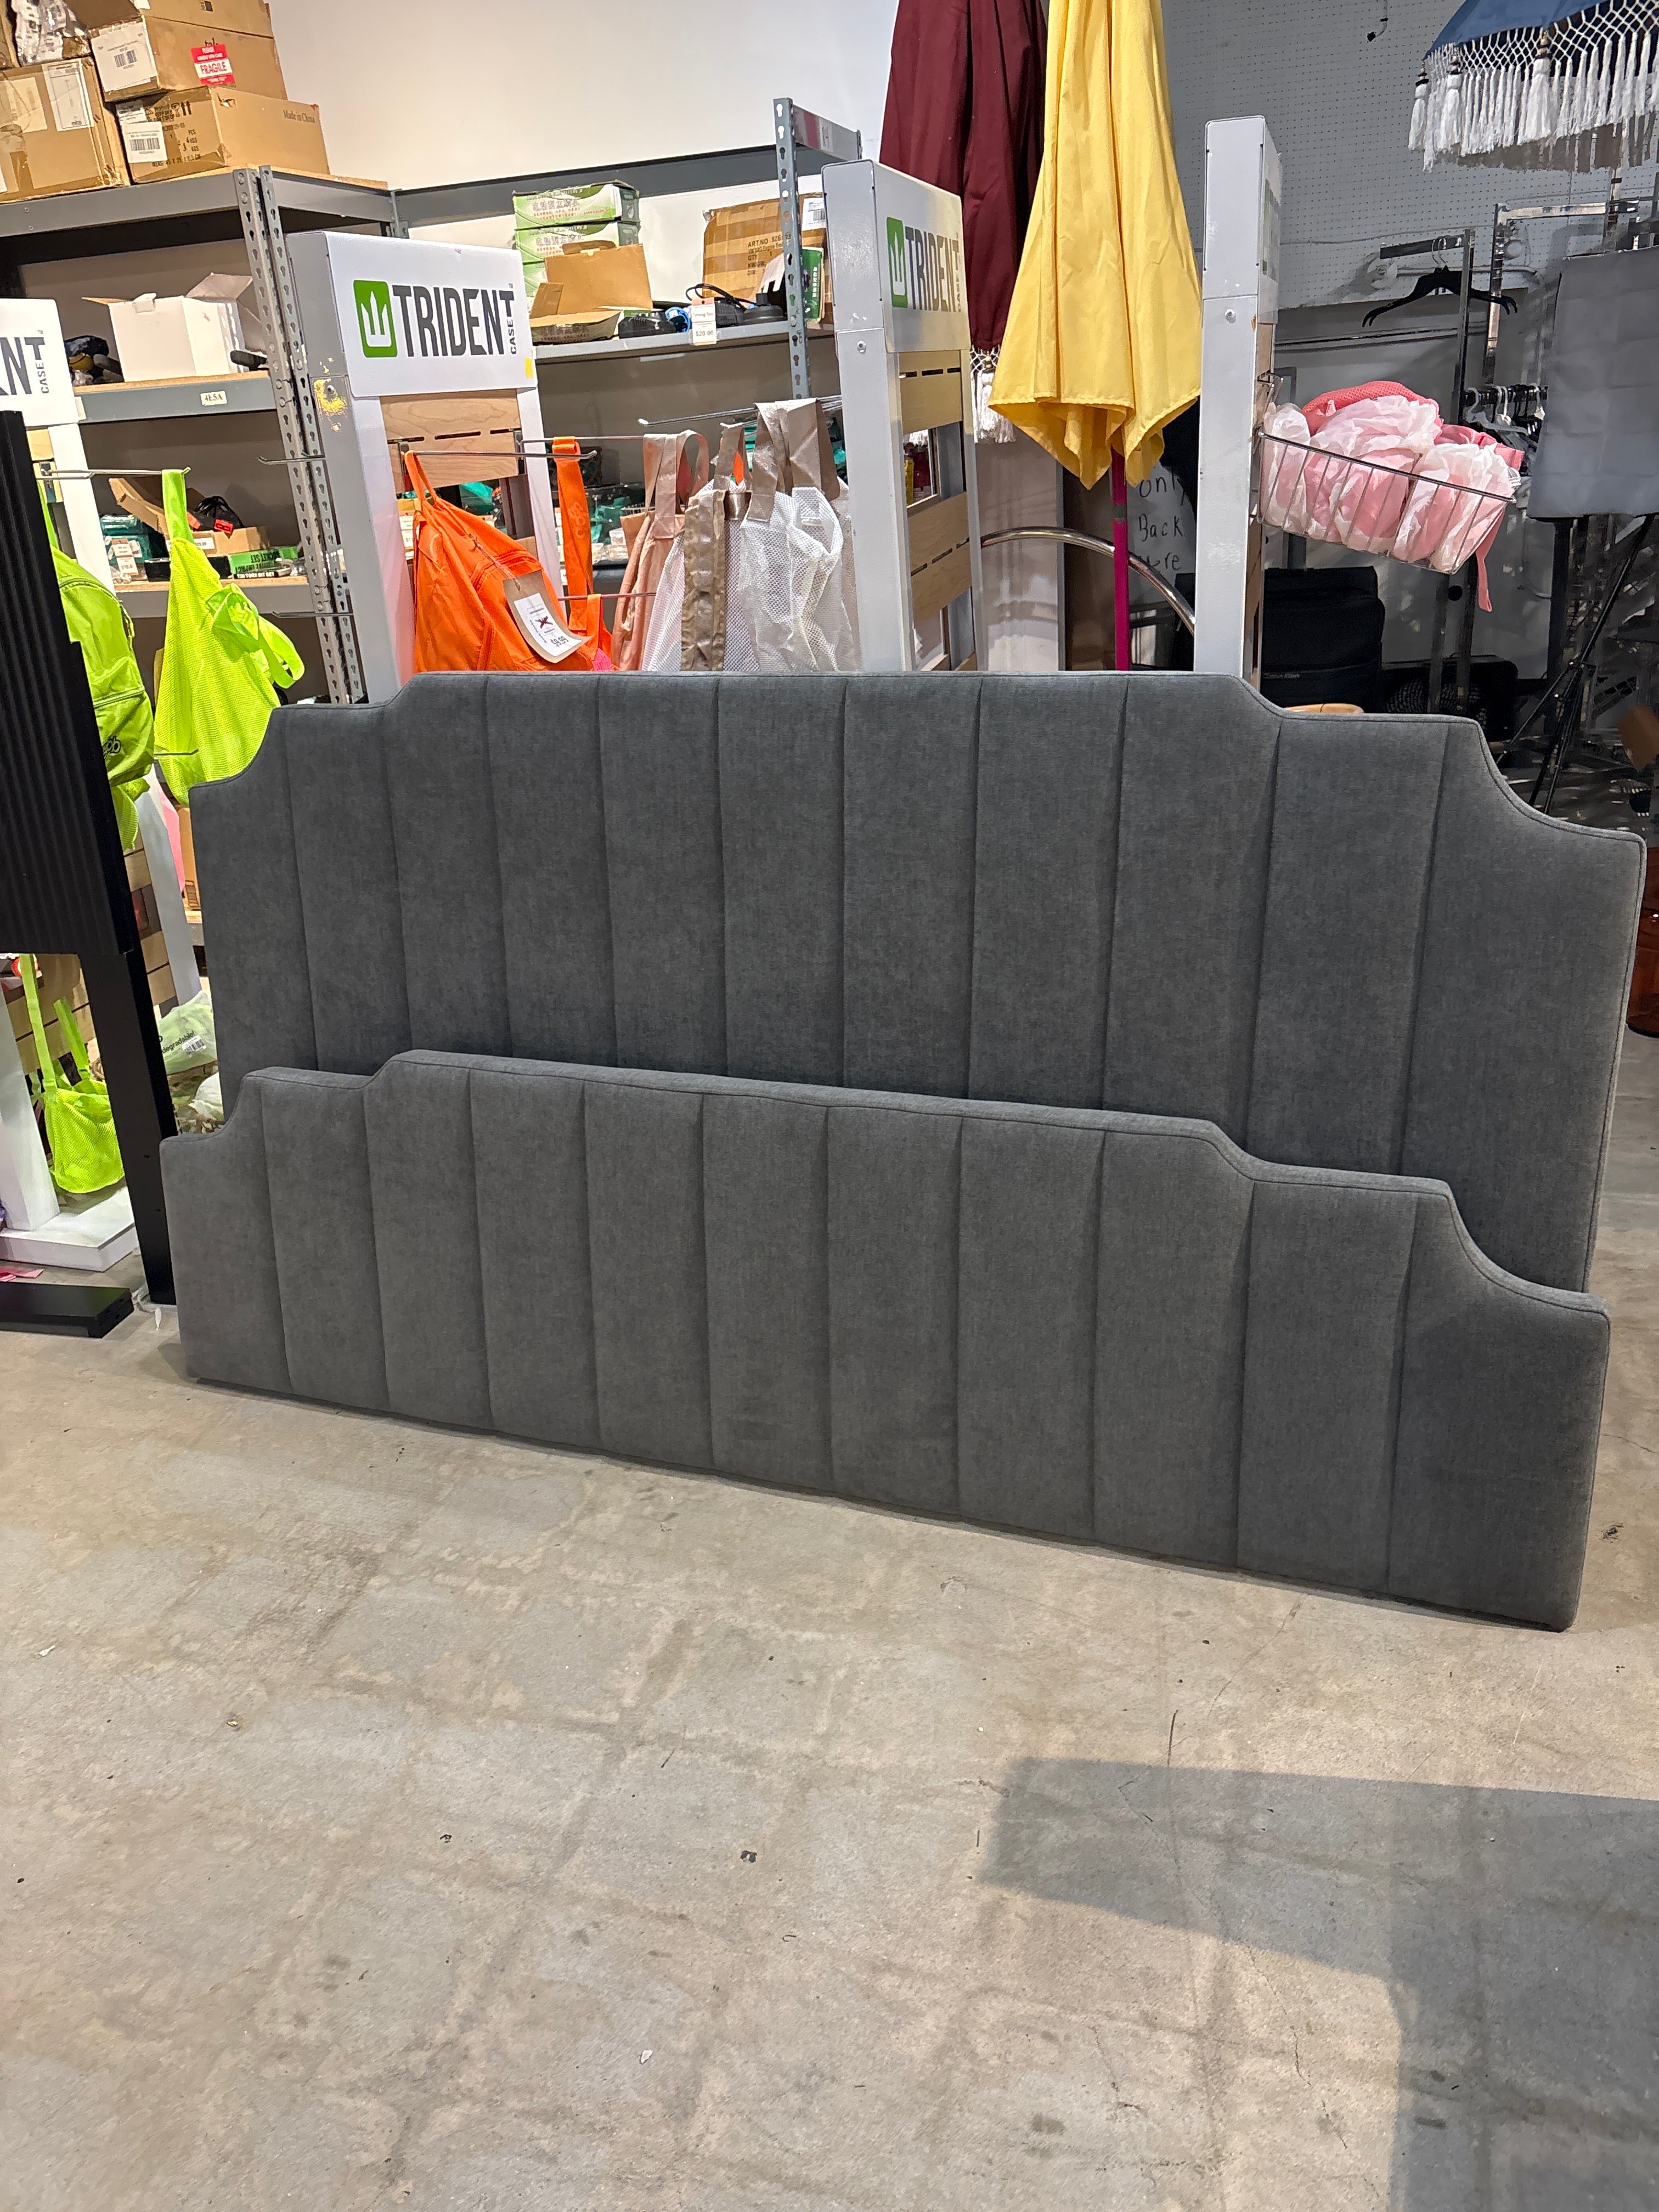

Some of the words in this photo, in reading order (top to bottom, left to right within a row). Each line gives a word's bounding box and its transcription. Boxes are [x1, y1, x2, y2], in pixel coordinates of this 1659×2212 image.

[200, 61, 227, 75] FRAGILE
[283, 110, 296, 120] Made
[905, 226, 959, 312] TRIDENT
[392, 285, 515, 357] TRIDENT
[506, 319, 517, 354] CASE
[0, 337, 45, 396] NT
[35, 362, 49, 394] CASE
[1139, 514, 1183, 542] Back
[550, 636, 569, 647] $9.99
